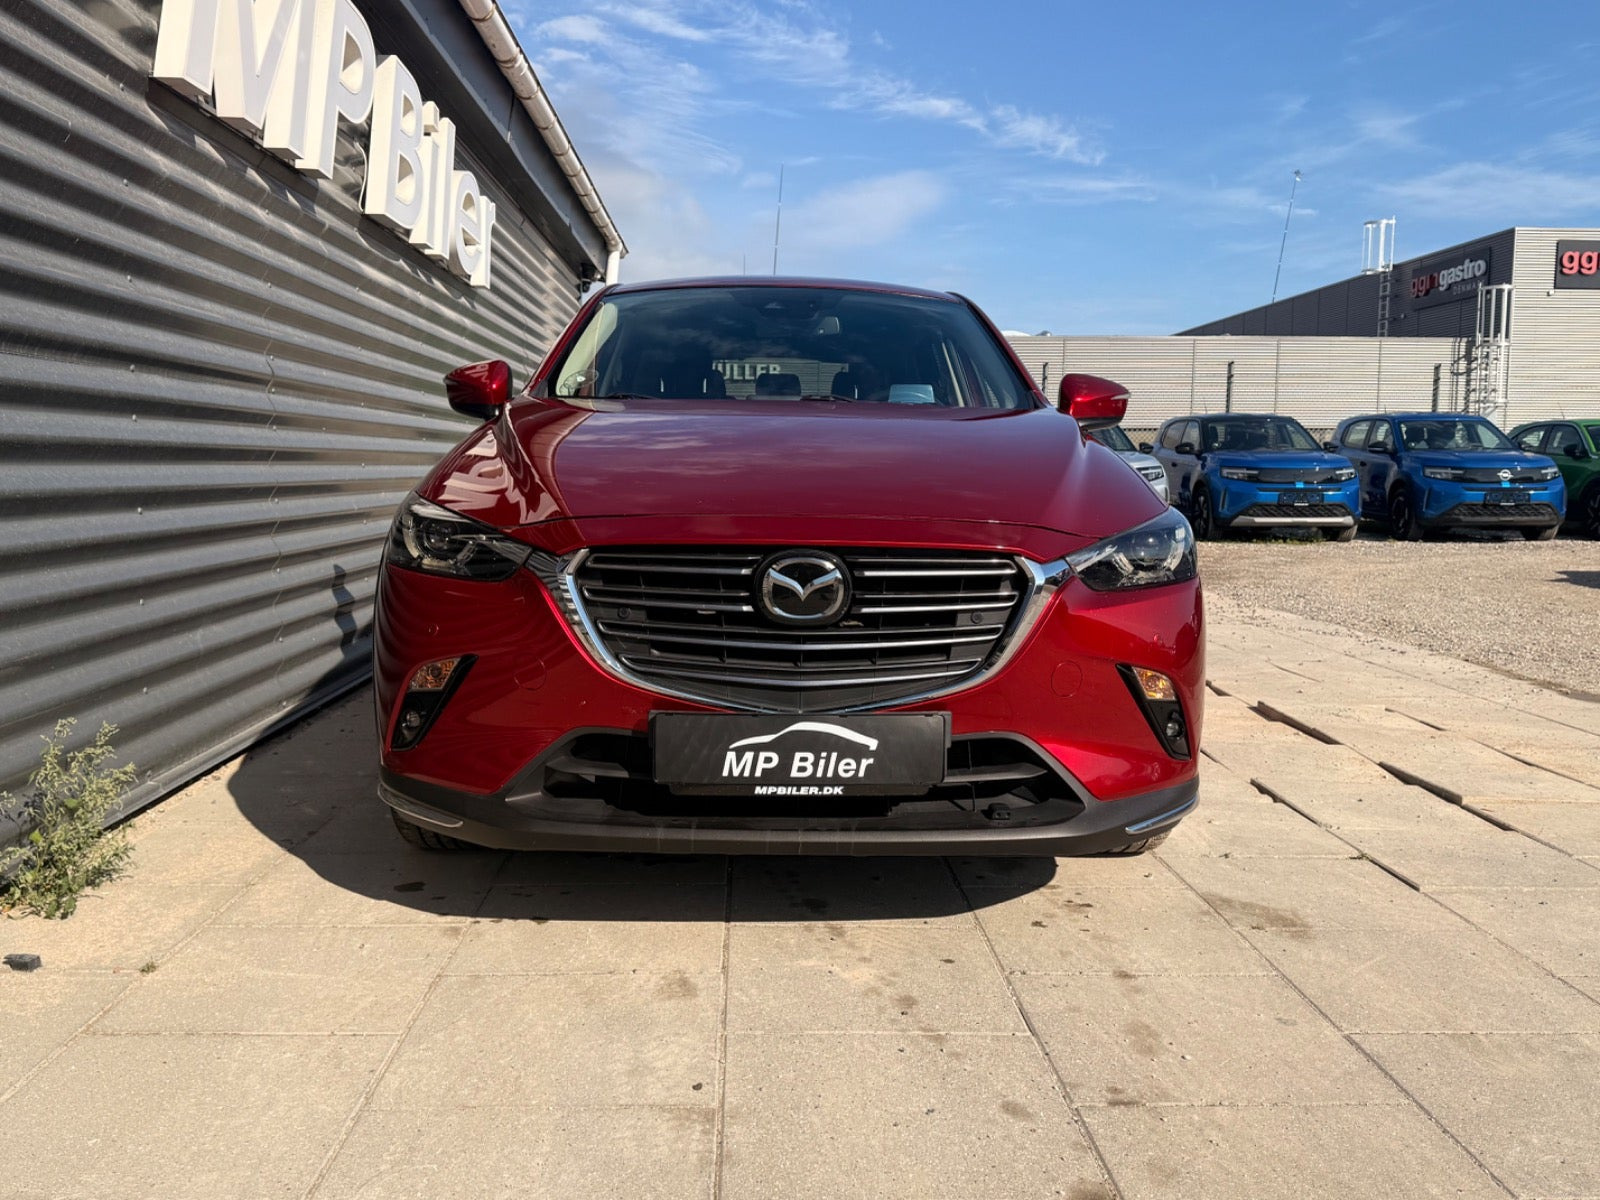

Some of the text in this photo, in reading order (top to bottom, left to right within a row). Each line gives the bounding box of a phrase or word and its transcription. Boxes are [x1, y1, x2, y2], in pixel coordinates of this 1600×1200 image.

[153, 0, 496, 289] MP Biler
[1562, 250, 1600, 275] gg
[1452, 279, 1486, 295] DENMA
[712, 359, 781, 380] ÜLLER
[722, 751, 874, 778] MP Biler
[754, 785, 844, 795] MPBILER.DK
